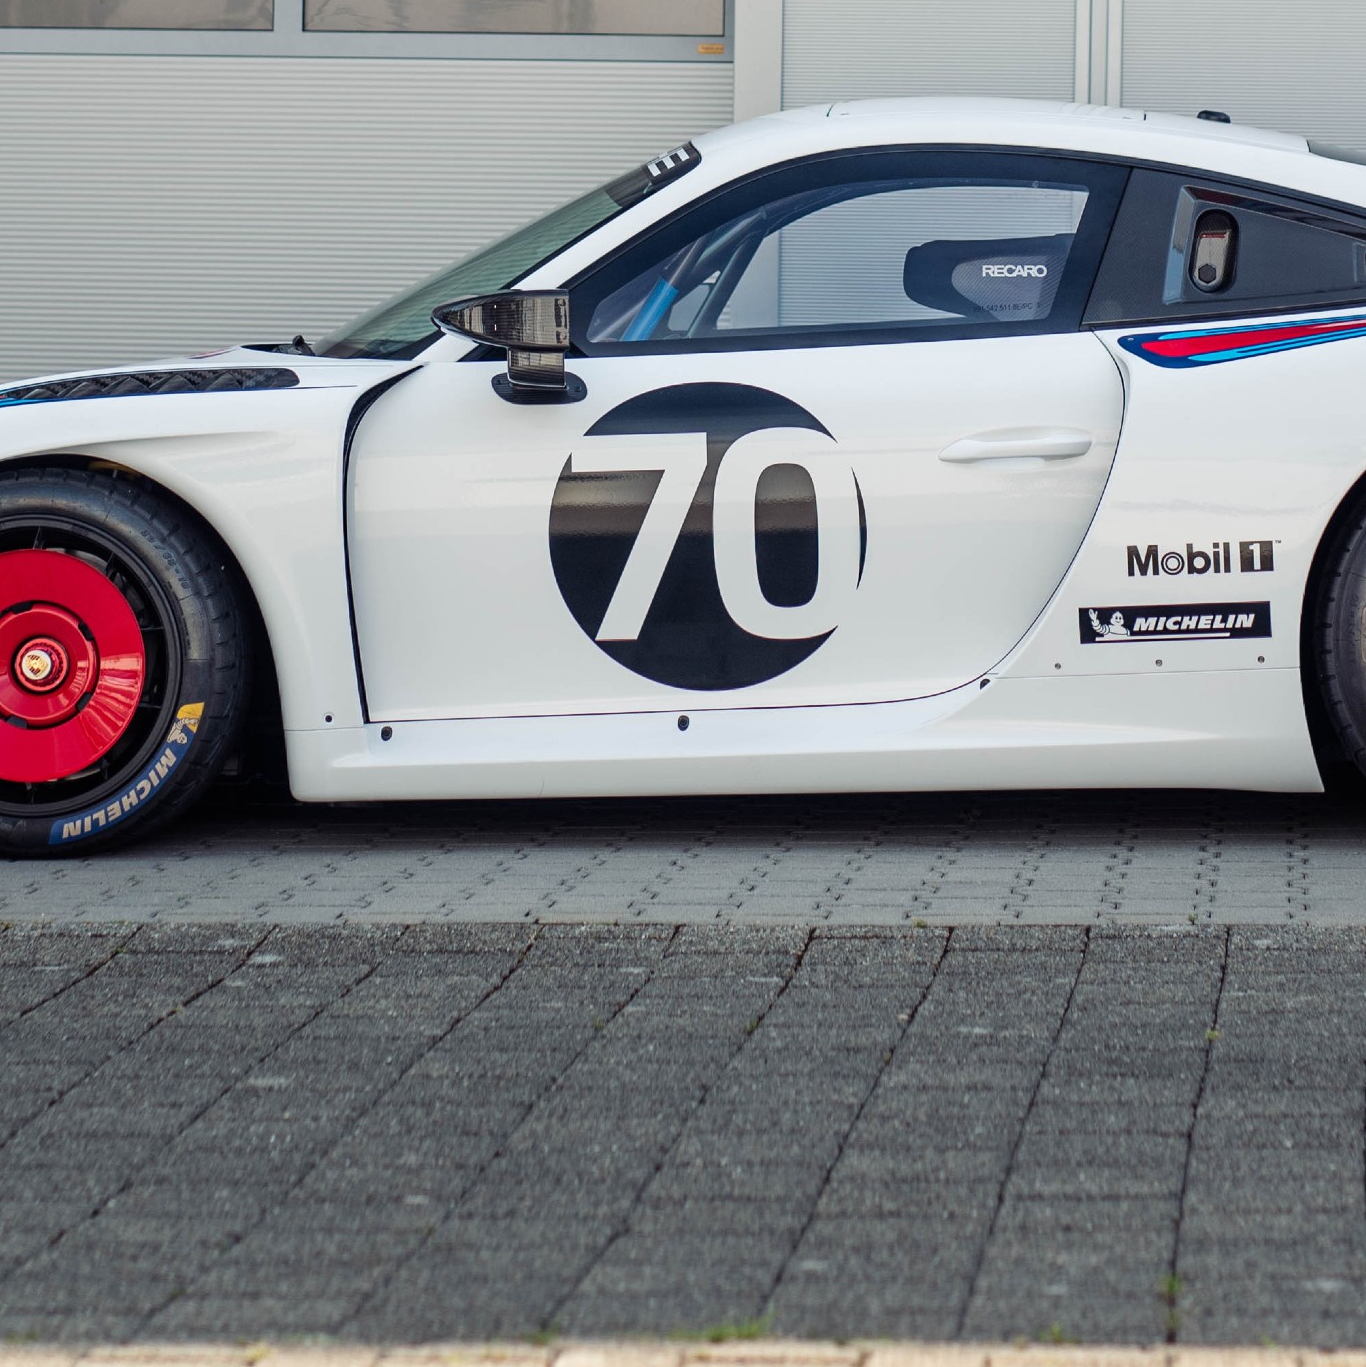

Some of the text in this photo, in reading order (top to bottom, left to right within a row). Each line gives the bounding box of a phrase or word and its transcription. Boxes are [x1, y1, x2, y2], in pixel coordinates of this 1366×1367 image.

[982, 264, 1048, 278] RECARO
[571, 426, 860, 641] 70
[1126, 541, 1232, 577] Mobil
[1133, 613, 1255, 632] MICHELIN
[61, 747, 177, 839] MICHELIN
